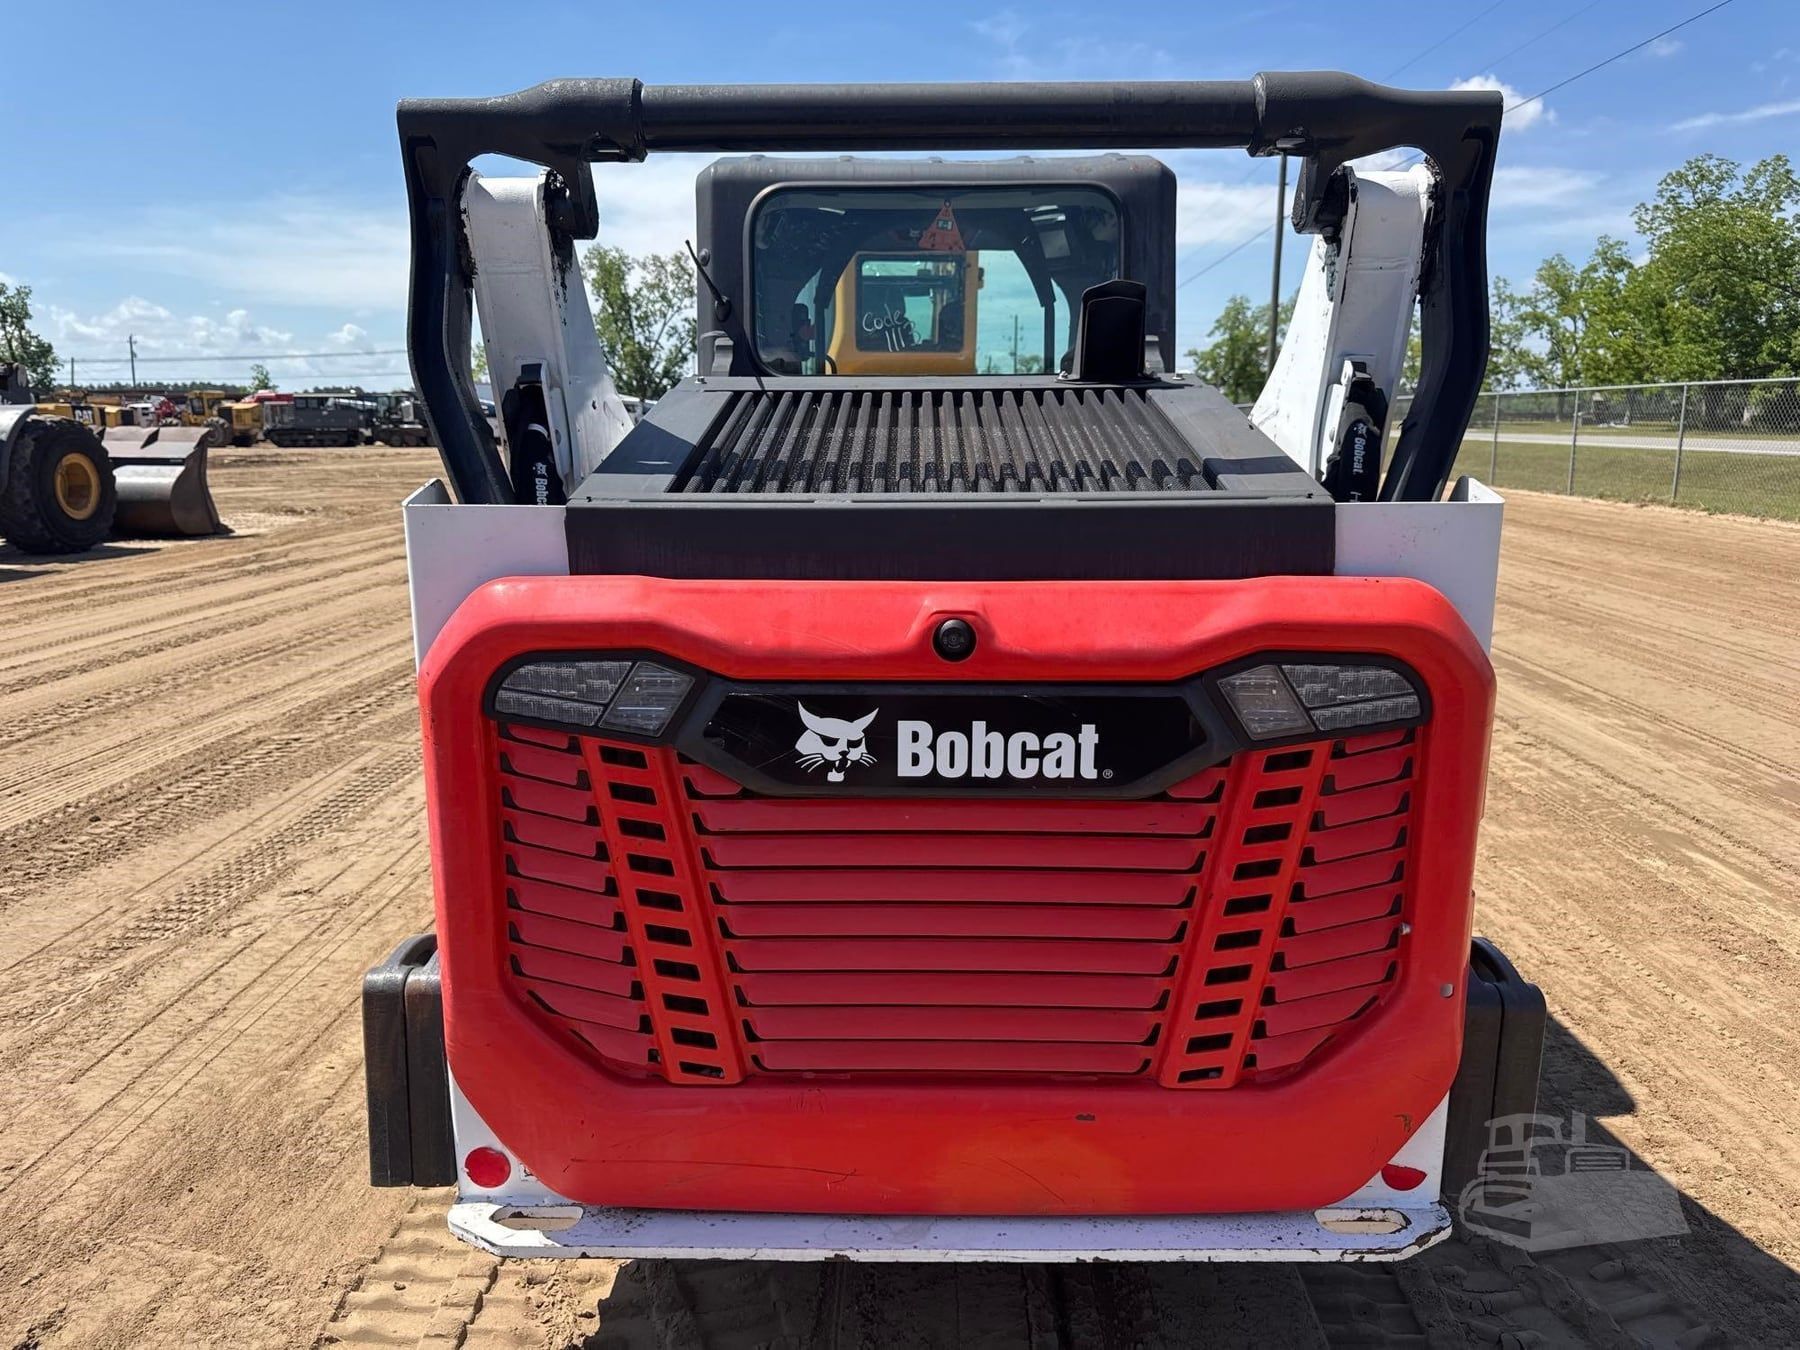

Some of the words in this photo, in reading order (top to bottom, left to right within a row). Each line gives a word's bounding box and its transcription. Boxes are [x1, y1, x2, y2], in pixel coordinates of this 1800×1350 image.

[863, 304, 901, 332] Code
[74, 409, 93, 424] CAT
[1353, 437, 1366, 475] Bobcat
[535, 477, 549, 506] Bobc
[897, 720, 1099, 779] Bobcat
